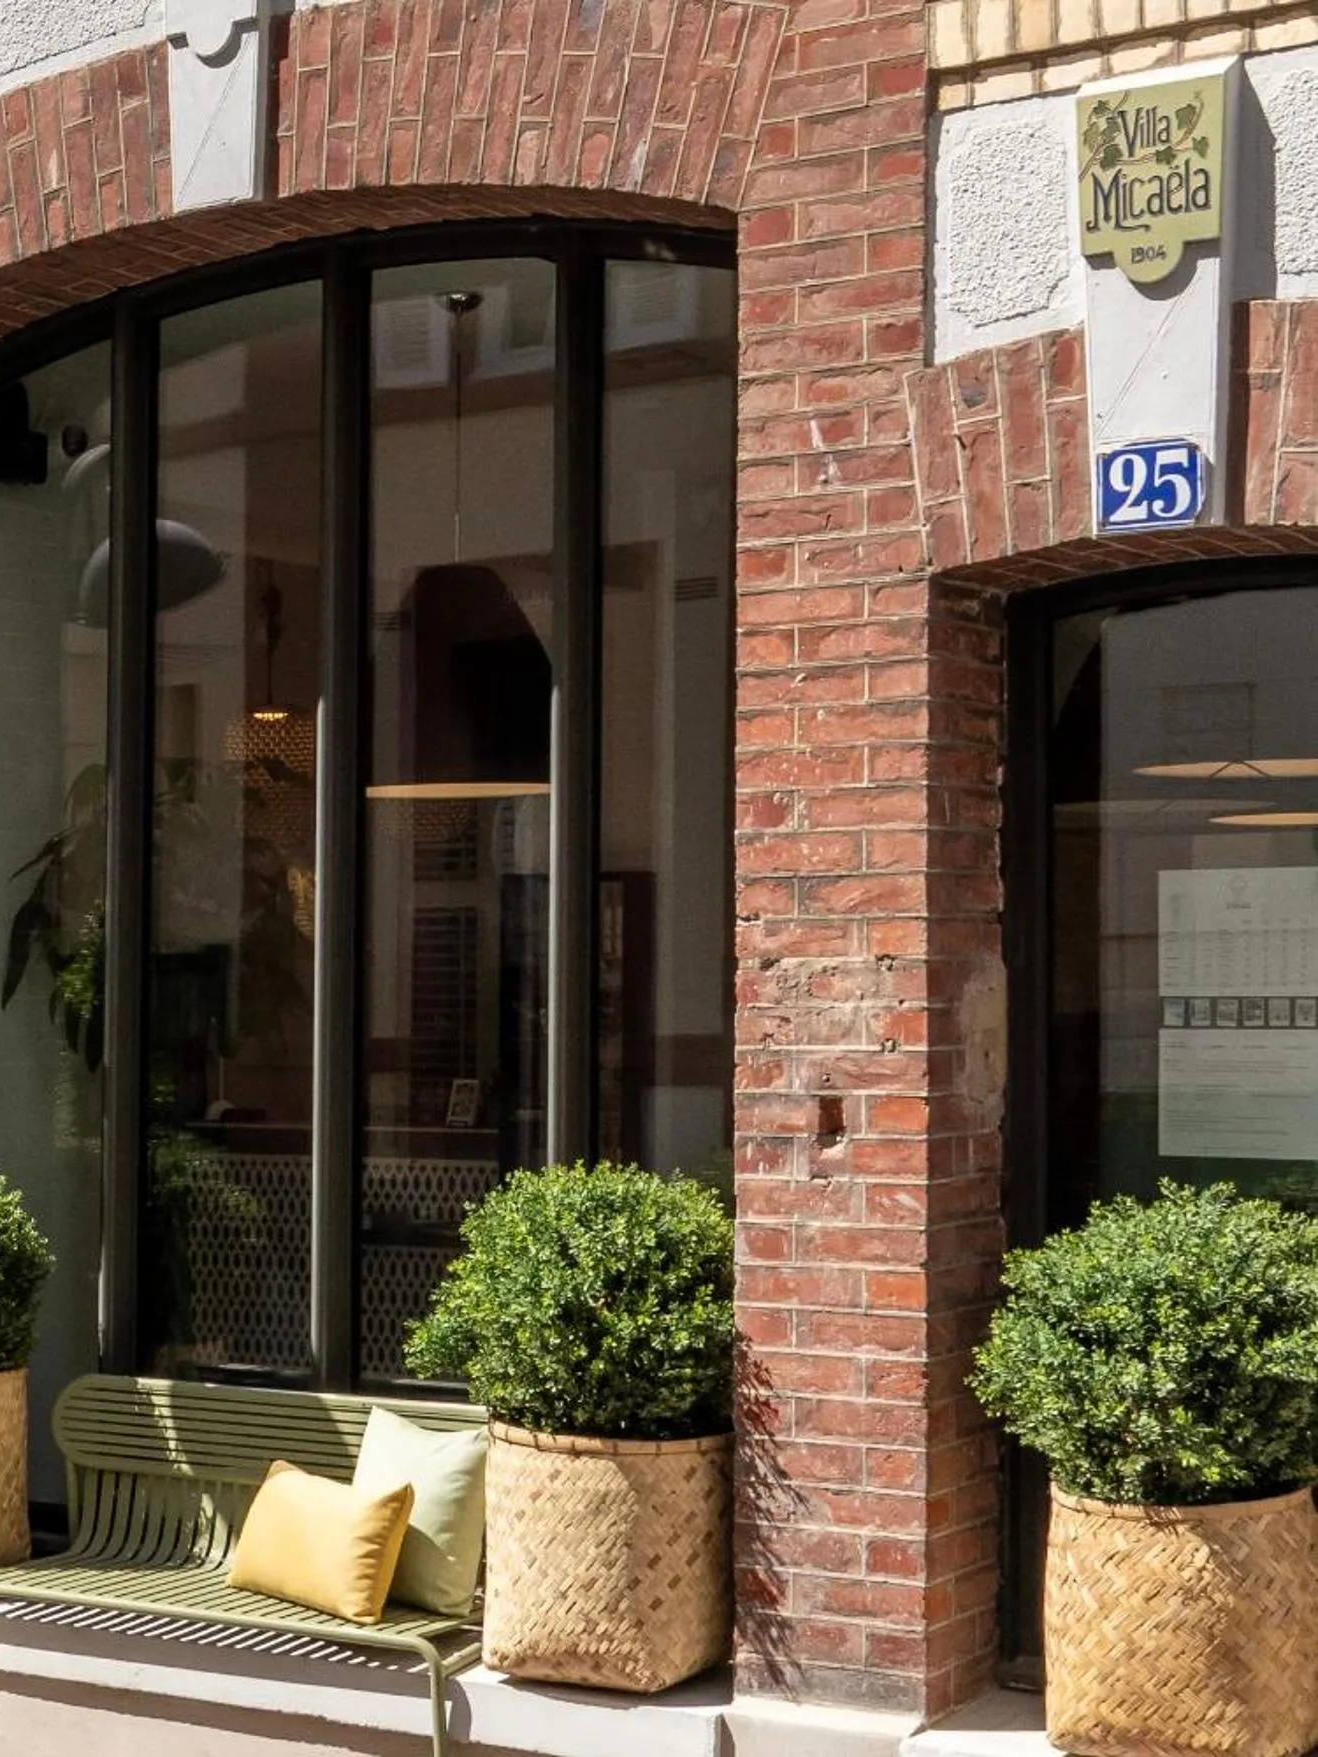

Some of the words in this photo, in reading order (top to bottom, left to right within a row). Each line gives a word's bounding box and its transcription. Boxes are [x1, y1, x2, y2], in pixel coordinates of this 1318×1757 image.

[1117, 105, 1172, 158] Villa
[1085, 158, 1212, 233] Micaëla
[1109, 447, 1193, 523] 25
